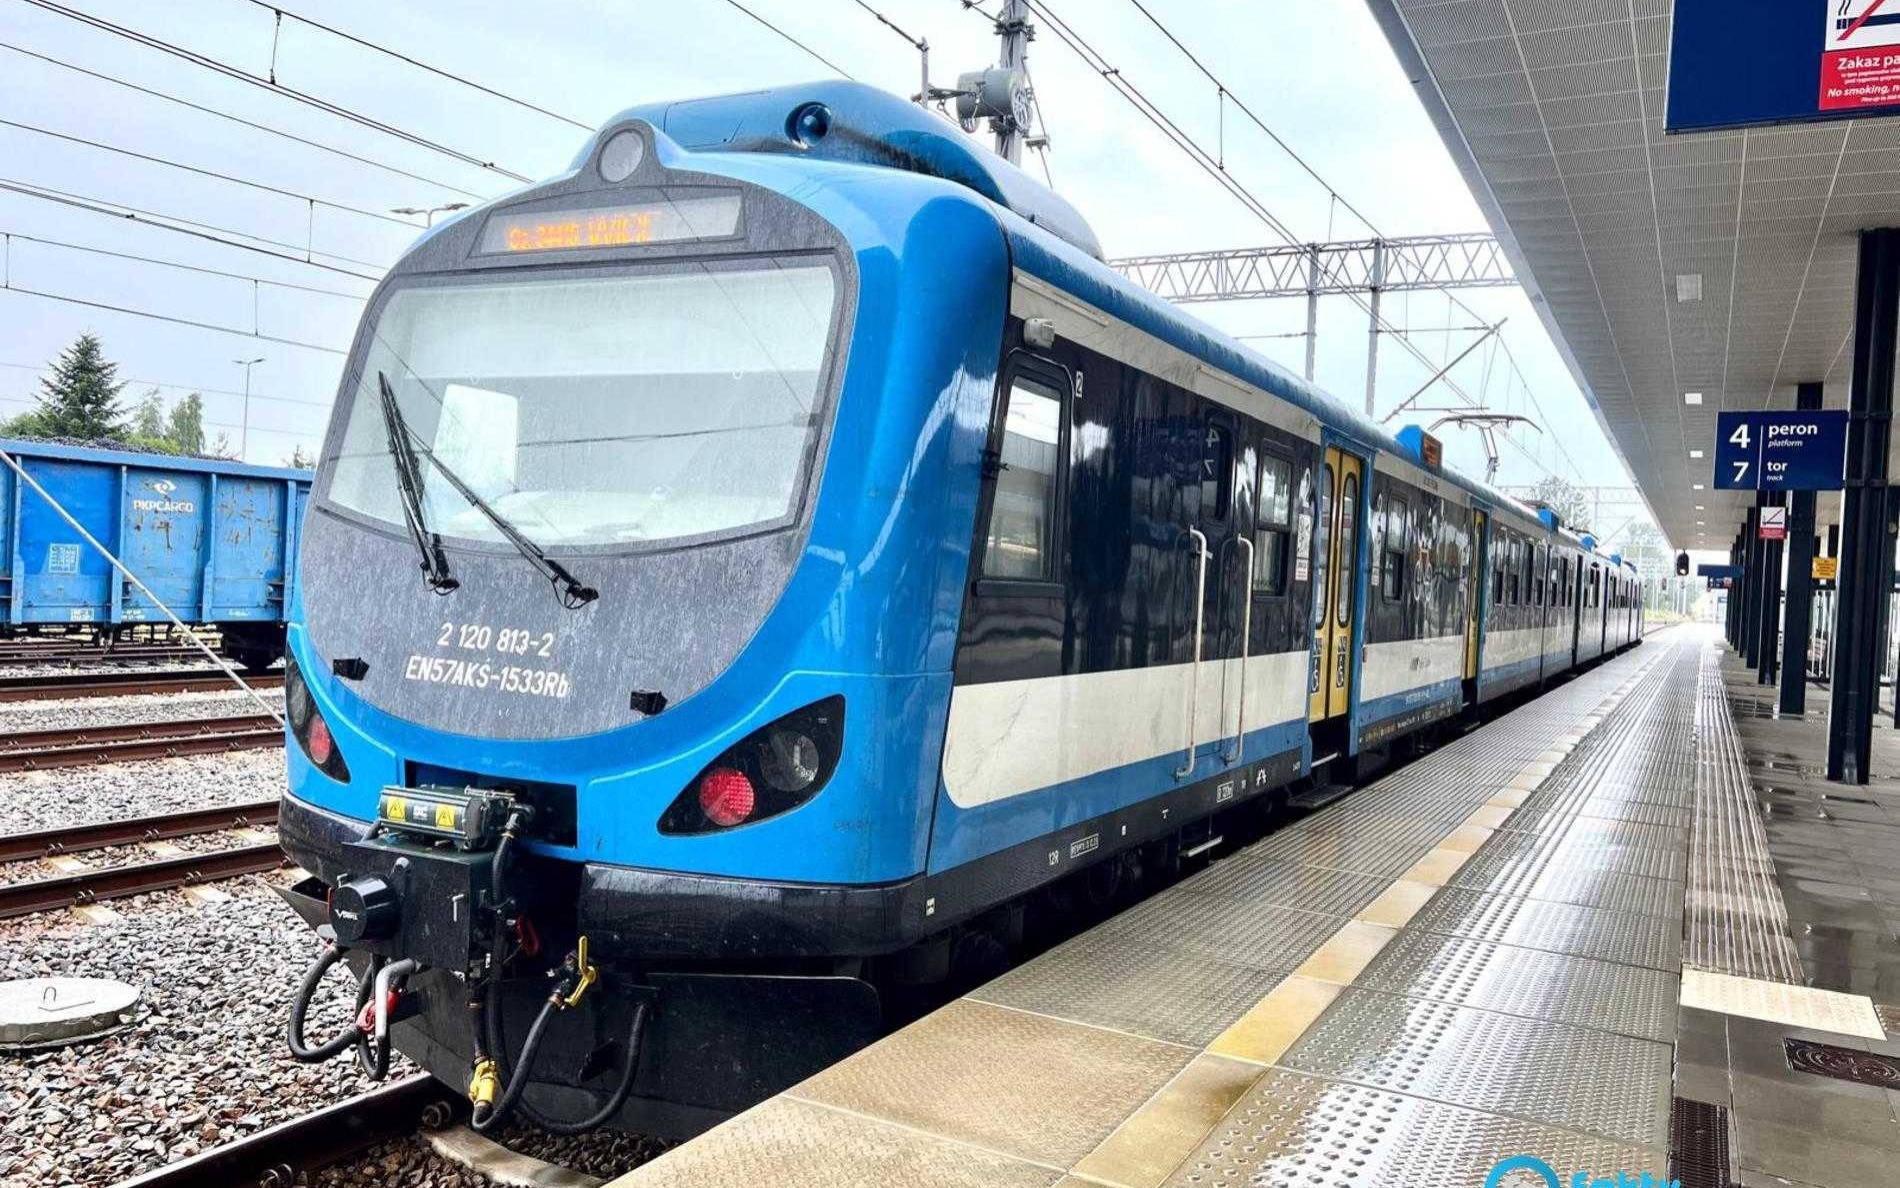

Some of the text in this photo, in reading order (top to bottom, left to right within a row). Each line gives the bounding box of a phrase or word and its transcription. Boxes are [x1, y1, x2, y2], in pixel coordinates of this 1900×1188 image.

[1837, 56, 1881, 70] Zakaz
[1827, 88, 1842, 98] No
[1844, 85, 1889, 96] smoking,
[1729, 424, 1818, 449] 4 peron
[1767, 439, 1803, 448] platform
[1733, 461, 1788, 483] 7 tor
[437, 622, 554, 657] 2 120 813-2
[405, 655, 571, 698] EN57AKŚ-1533Rb
